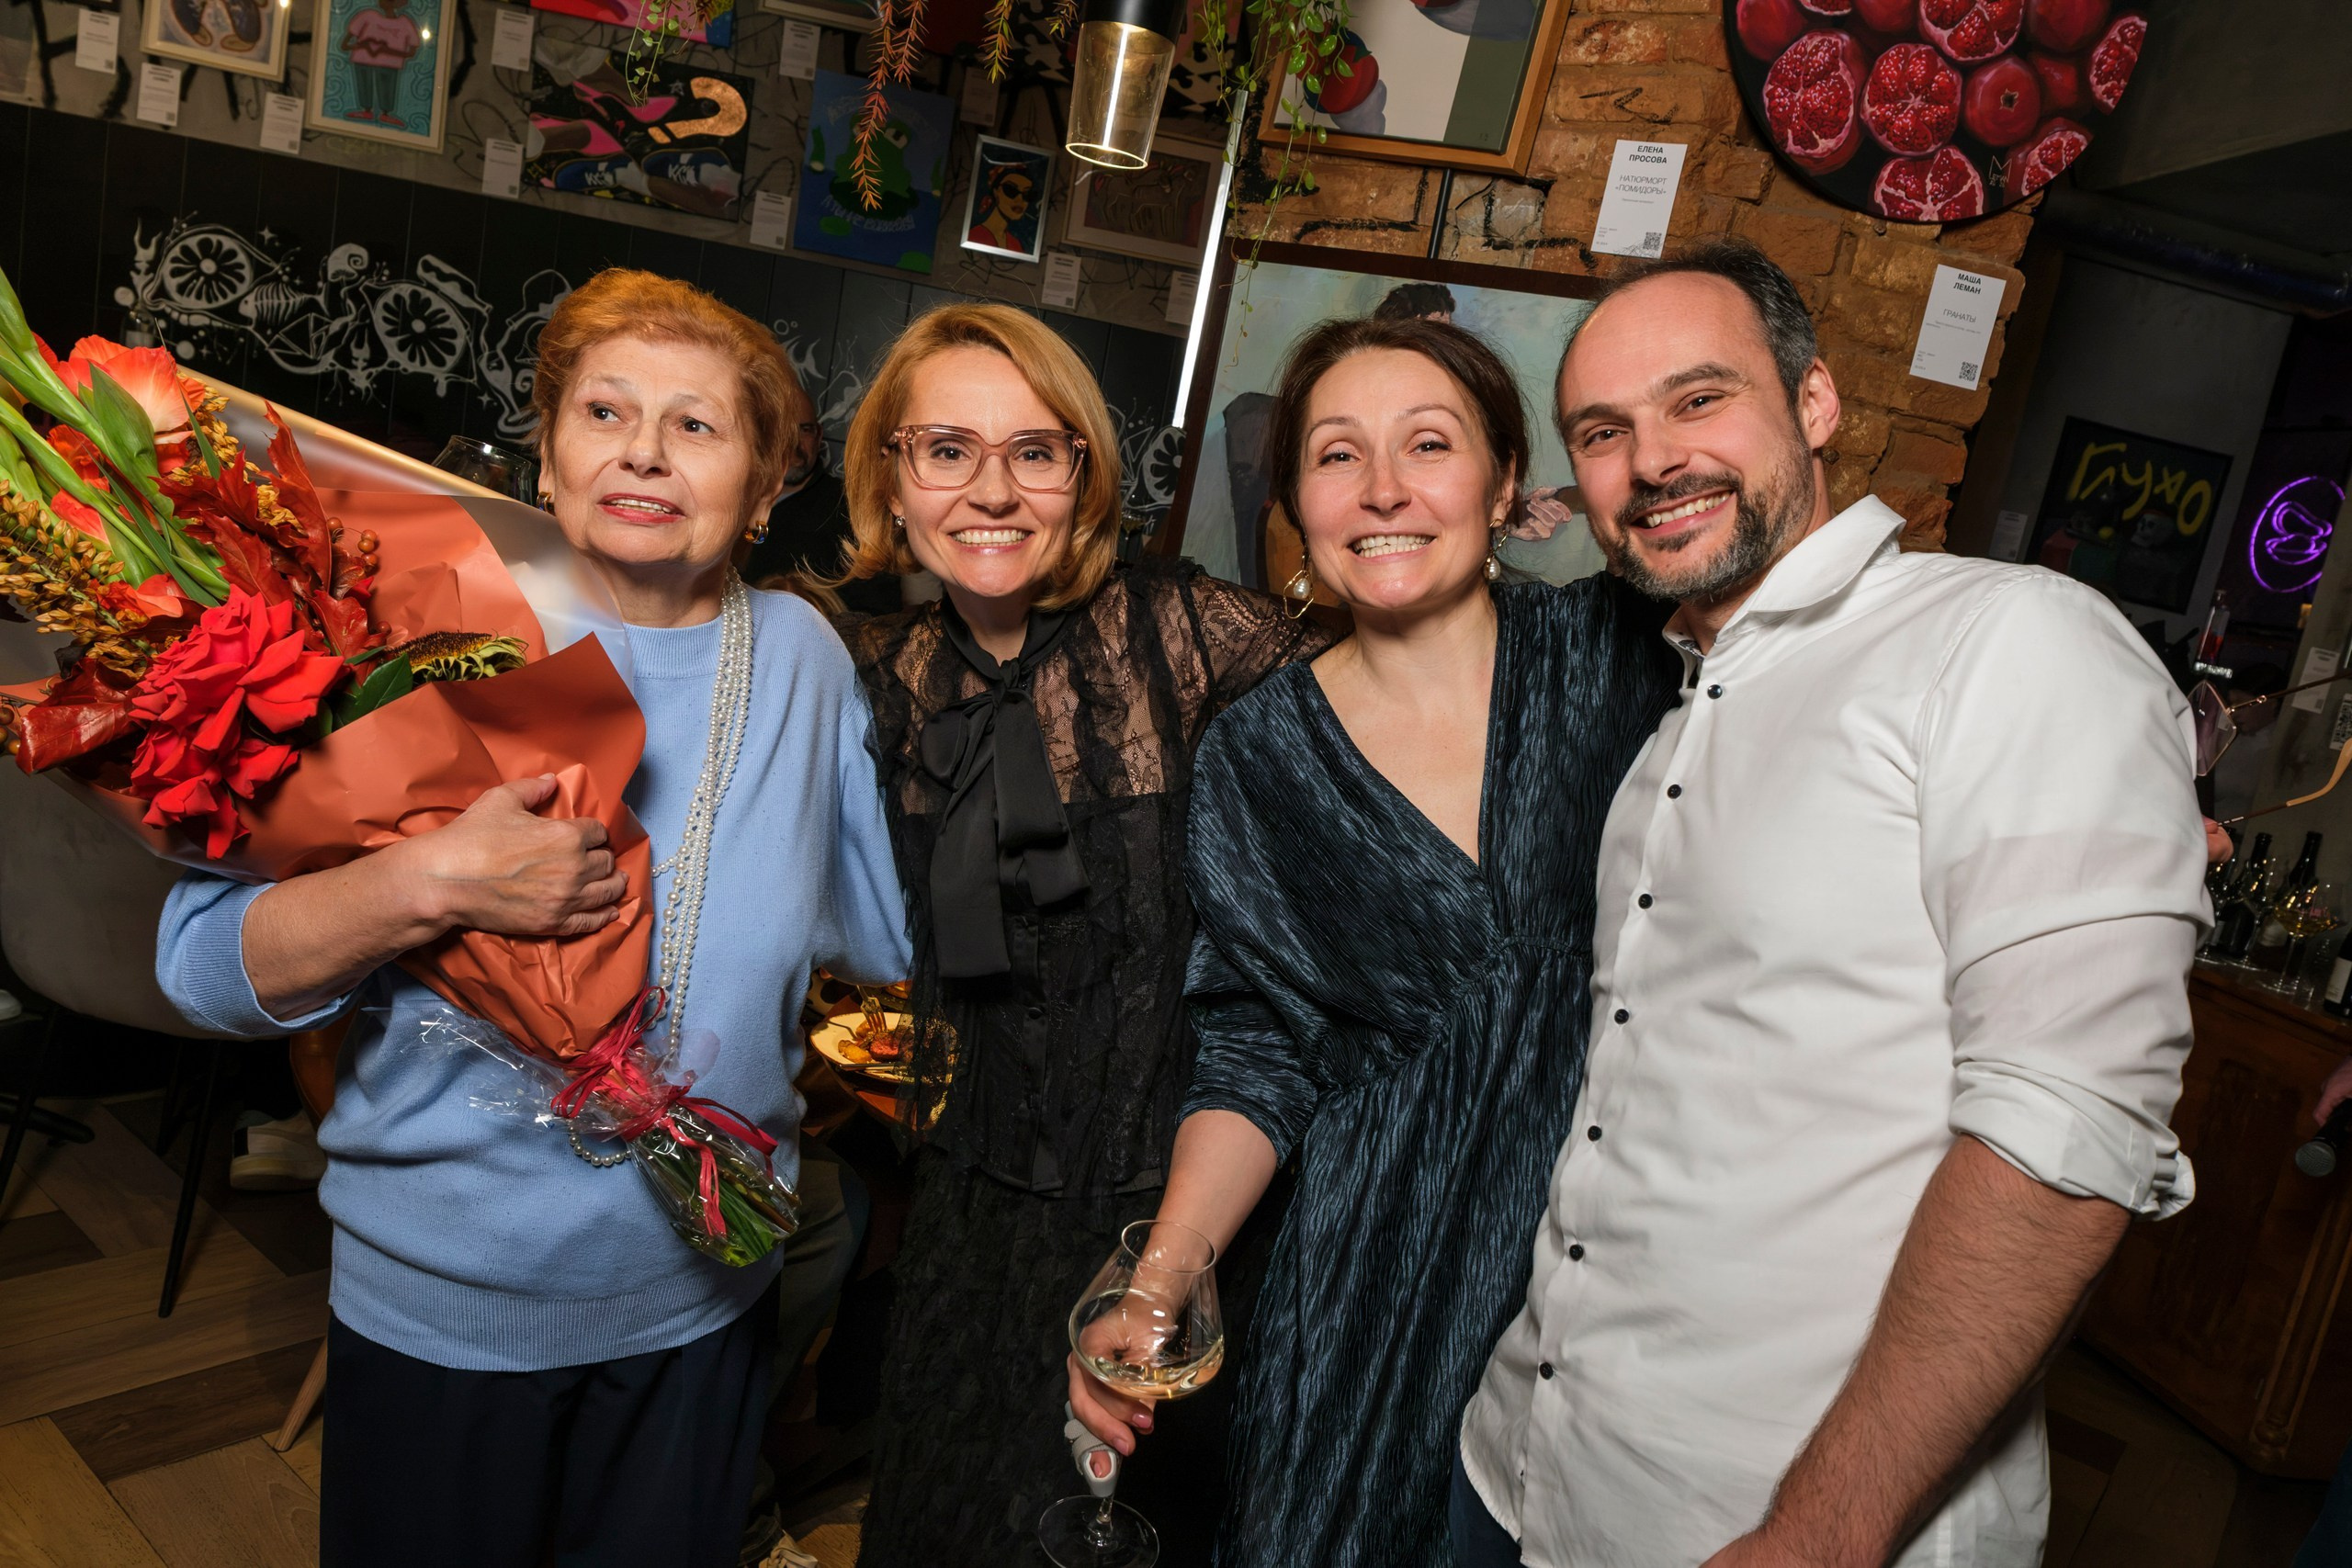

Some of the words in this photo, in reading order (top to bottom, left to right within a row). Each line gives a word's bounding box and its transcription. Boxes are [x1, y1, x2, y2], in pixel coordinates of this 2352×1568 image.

[1637, 145, 1664, 153] ЕЛЕНА
[1629, 154, 1668, 164] ПРОСОВА
[1619, 175, 1668, 185] НАТЮРМОРТ
[1957, 273, 1982, 285] МАША
[1953, 282, 1982, 295] ЛЕМАН
[1942, 309, 1977, 323] ГРАНАТЫ
